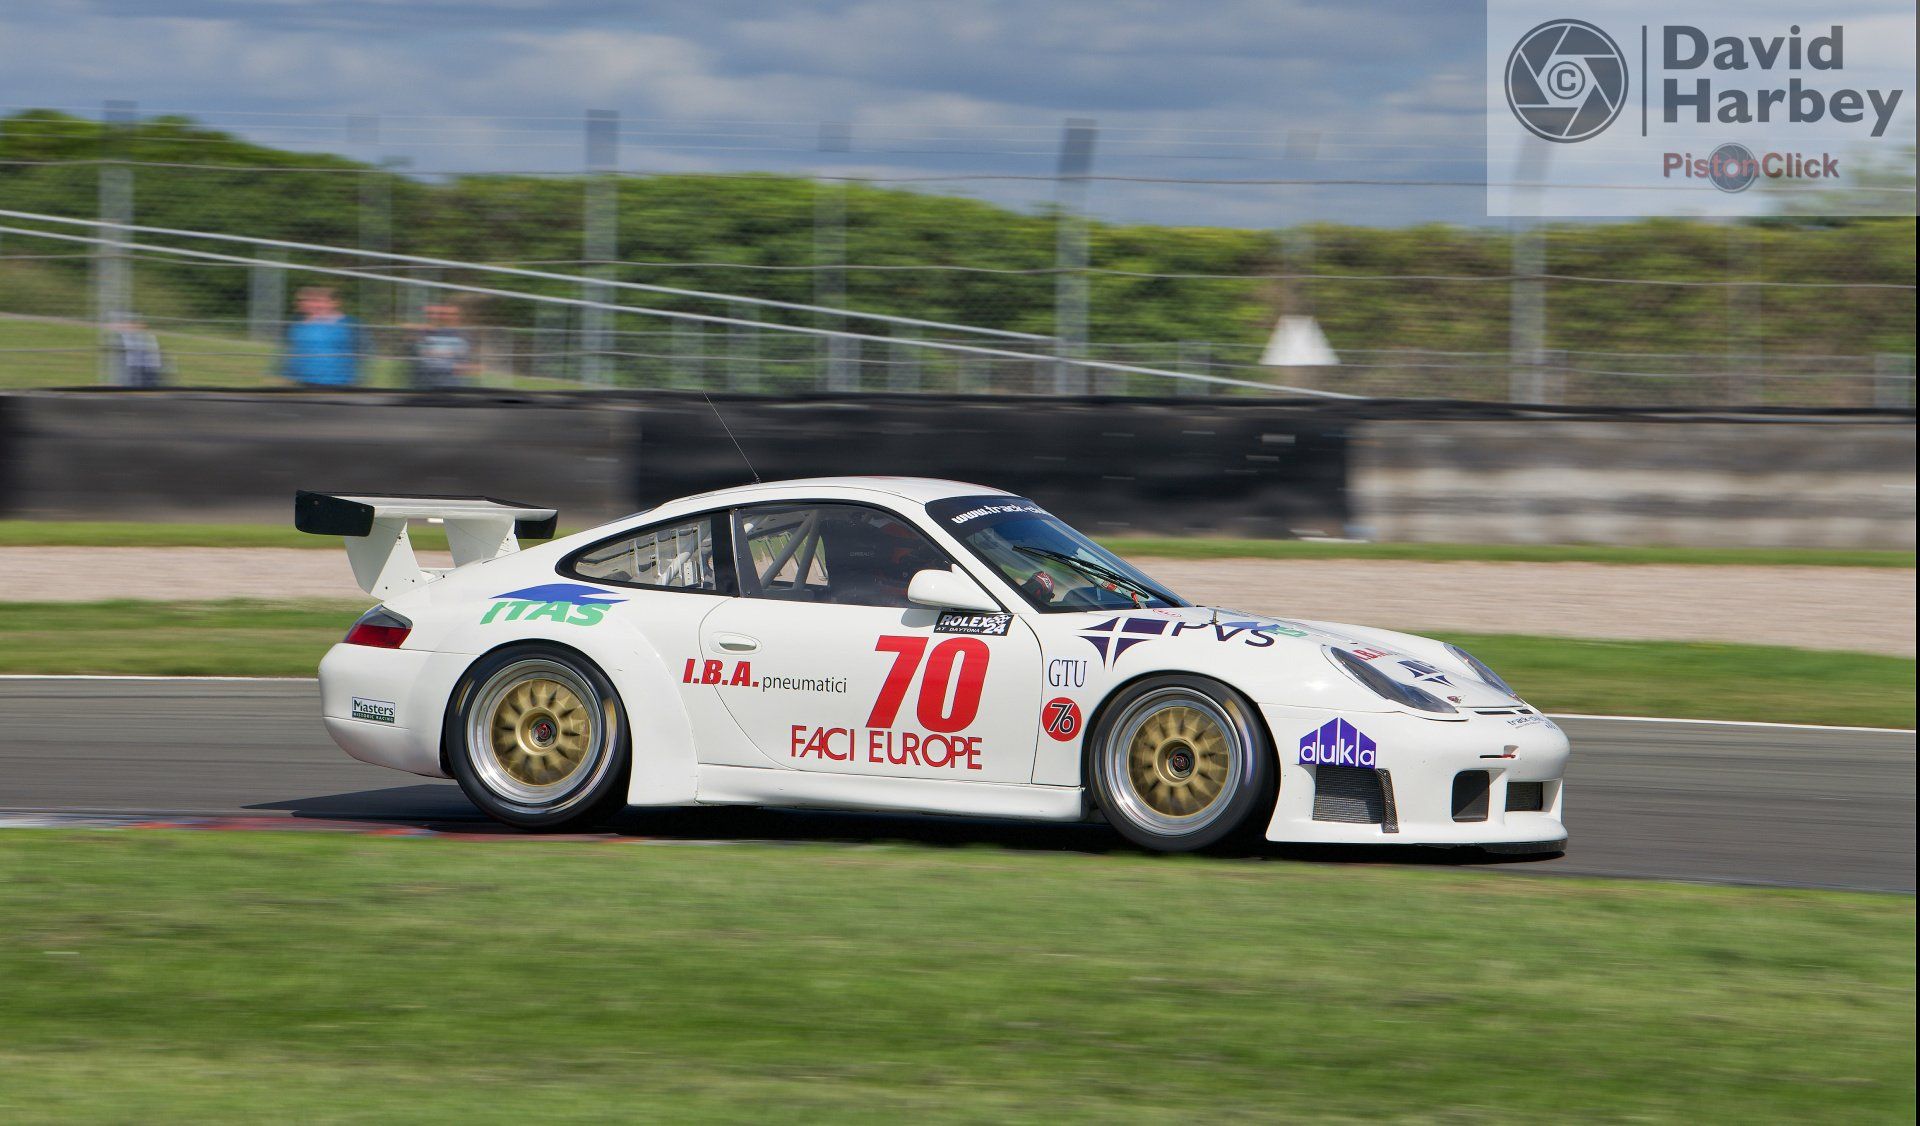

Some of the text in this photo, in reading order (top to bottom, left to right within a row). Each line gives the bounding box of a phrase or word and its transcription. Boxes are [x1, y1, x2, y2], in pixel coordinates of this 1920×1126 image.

[480, 601, 612, 627] ITAS
[940, 614, 1006, 634] ROLEX 24
[683, 658, 847, 693] I.B.A. pneumatici
[865, 634, 990, 733] 70
[1048, 658, 1087, 688] GTU
[353, 699, 394, 716] Masters
[1048, 702, 1075, 734] 76
[791, 724, 983, 770] FACI EUROPE
[1300, 738, 1376, 766] duka
